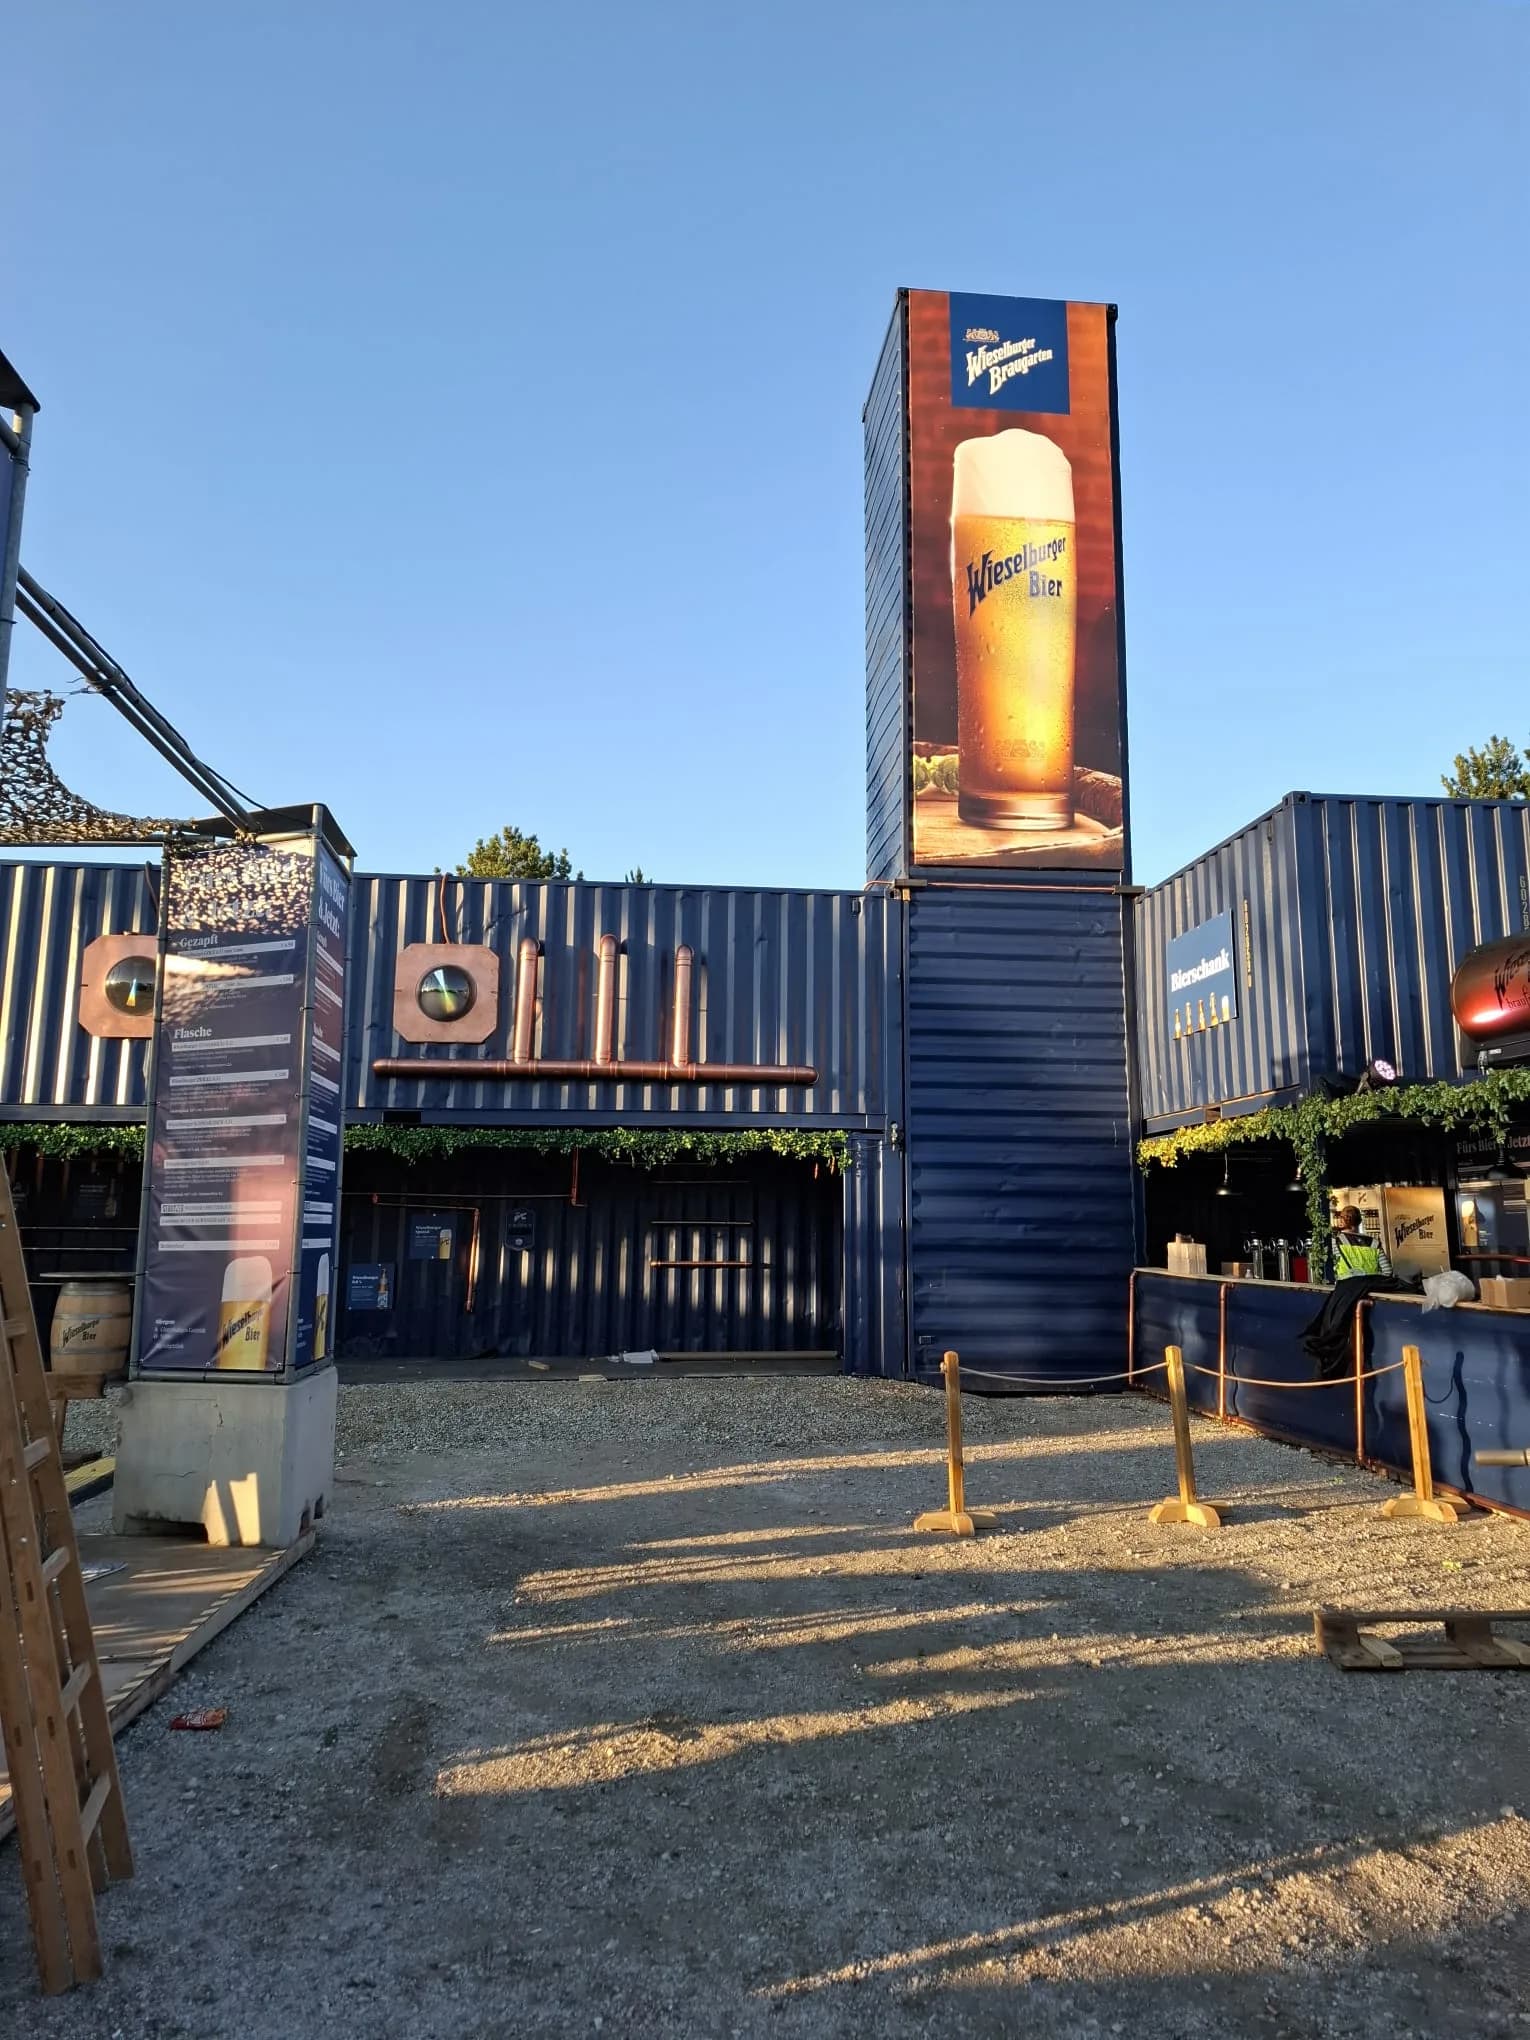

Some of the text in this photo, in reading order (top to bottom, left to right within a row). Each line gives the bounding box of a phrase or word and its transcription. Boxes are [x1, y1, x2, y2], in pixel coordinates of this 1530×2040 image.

[966, 338, 1035, 387] Wieselburger
[989, 349, 1053, 395] Braugarten
[967, 537, 1066, 617] Wieselburger
[1029, 571, 1062, 597] Bier
[180, 934, 219, 948] Gezapft
[1171, 948, 1230, 992] Bierschank
[174, 1027, 212, 1039] Flasche
[1419, 1229, 1433, 1239] Bier
[246, 1327, 260, 1341] Bier
